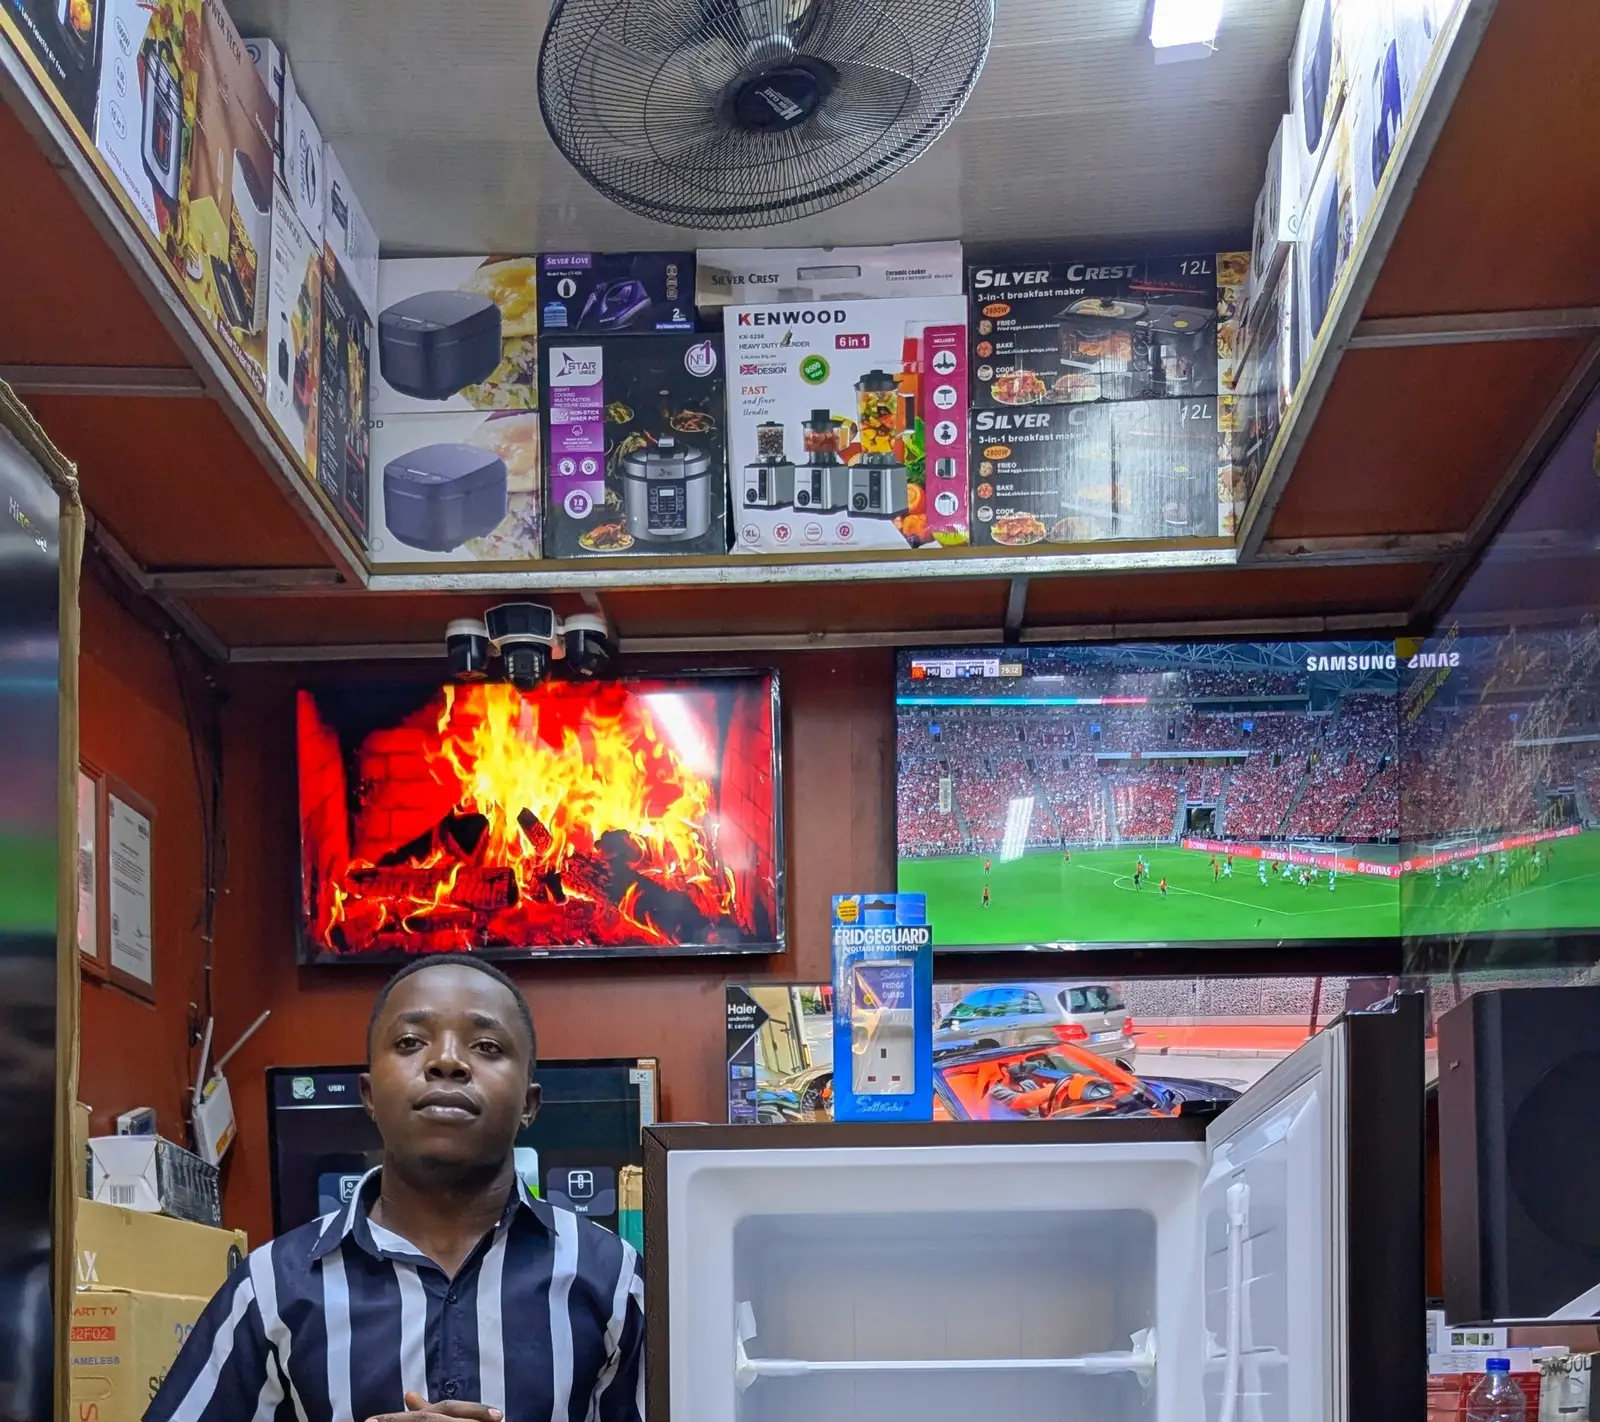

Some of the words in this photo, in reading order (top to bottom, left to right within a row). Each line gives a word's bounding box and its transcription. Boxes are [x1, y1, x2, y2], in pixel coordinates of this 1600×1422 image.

[546, 257, 569, 266] SILVER
[570, 256, 589, 265] LOVE
[1180, 260, 1212, 276] 12L
[711, 274, 745, 286] SILVER
[749, 273, 780, 285] CREST
[974, 269, 1050, 289] SILVER
[1067, 264, 1137, 282] CREST
[977, 291, 1006, 302] 3-in-1
[1006, 289, 1054, 301] breakfast
[1055, 287, 1085, 297] maker
[738, 310, 847, 327] KENWOOD
[839, 337, 846, 347] 6
[848, 337, 859, 347] in
[861, 336, 867, 346] 1
[568, 361, 597, 371] STAR
[757, 366, 787, 375] DESIGN
[996, 366, 1015, 374] COOK
[741, 385, 768, 396] FAST
[742, 397, 757, 405] and
[757, 397, 776, 407] finer
[1181, 404, 1212, 420] 12L
[975, 411, 1051, 431] SILVER
[978, 433, 1006, 444] 3-in-1
[1007, 432, 1055, 443] breakfast
[1055, 431, 1085, 441] maker
[745, 529, 757, 537] XL
[1306, 655, 1397, 672] SAMSUNG
[927, 668, 940, 676] MU
[945, 668, 951, 676] 0
[970, 667, 983, 676] INT
[988, 667, 994, 675] 0
[1266, 851, 1286, 861] CHIVAS
[1365, 863, 1392, 876] CHIVAS
[835, 928, 930, 946] FRIDGEGUARD
[847, 945, 874, 953] VOLTAGE
[875, 944, 919, 953] PROTECTION
[727, 1003, 757, 1015] Haier
[72, 1307, 97, 1316] ART
[101, 1306, 117, 1316] TV
